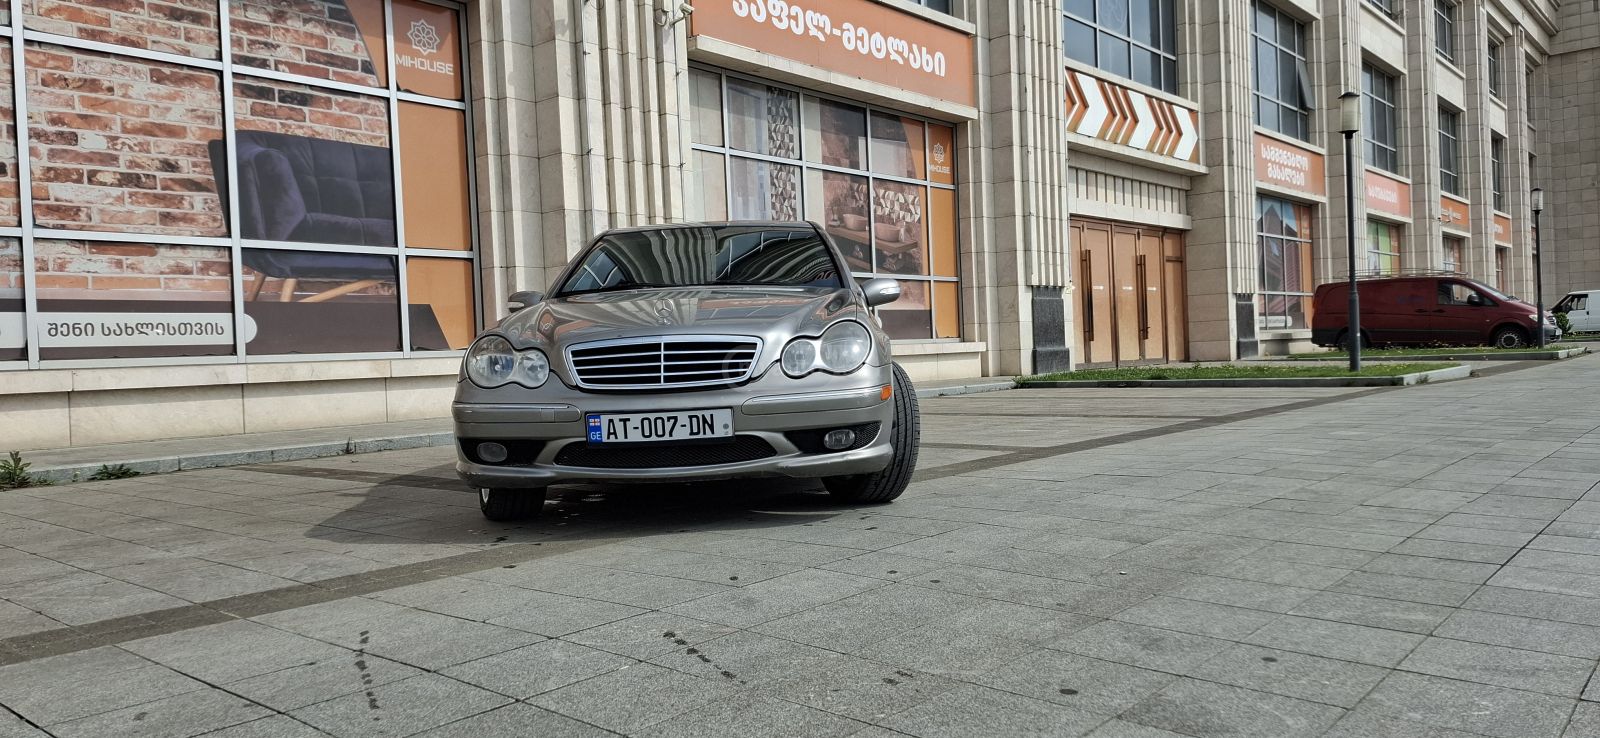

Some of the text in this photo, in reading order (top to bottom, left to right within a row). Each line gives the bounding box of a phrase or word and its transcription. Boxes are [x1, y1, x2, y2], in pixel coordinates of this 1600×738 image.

[396, 54, 454, 75] MIHOUSE
[47, 322, 225, 337] შენი სახლისთვის
[590, 431, 602, 440] GE
[606, 413, 715, 440] AT-007-DN
